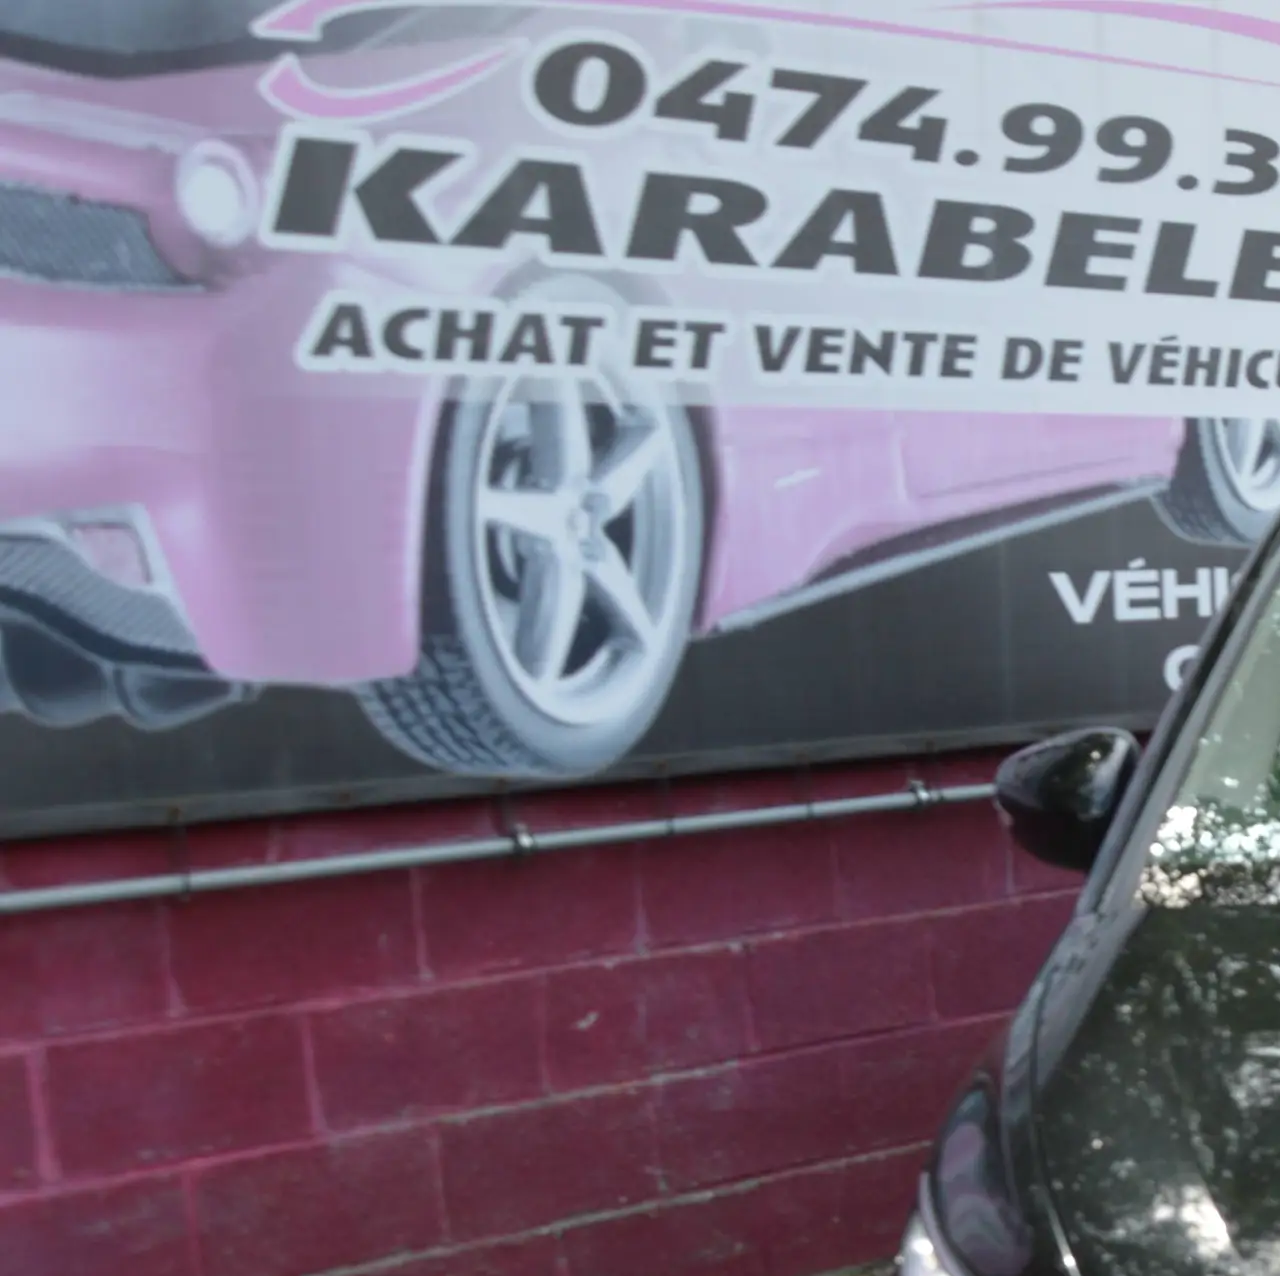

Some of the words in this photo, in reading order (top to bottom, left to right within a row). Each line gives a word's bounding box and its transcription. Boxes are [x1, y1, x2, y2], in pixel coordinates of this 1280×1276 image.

[310, 303, 605, 367] ACHAT
[633, 318, 727, 371] ET
[753, 324, 979, 379] VENTE
[1001, 336, 1084, 382] DE
[1048, 558, 1243, 625] VÉHI
